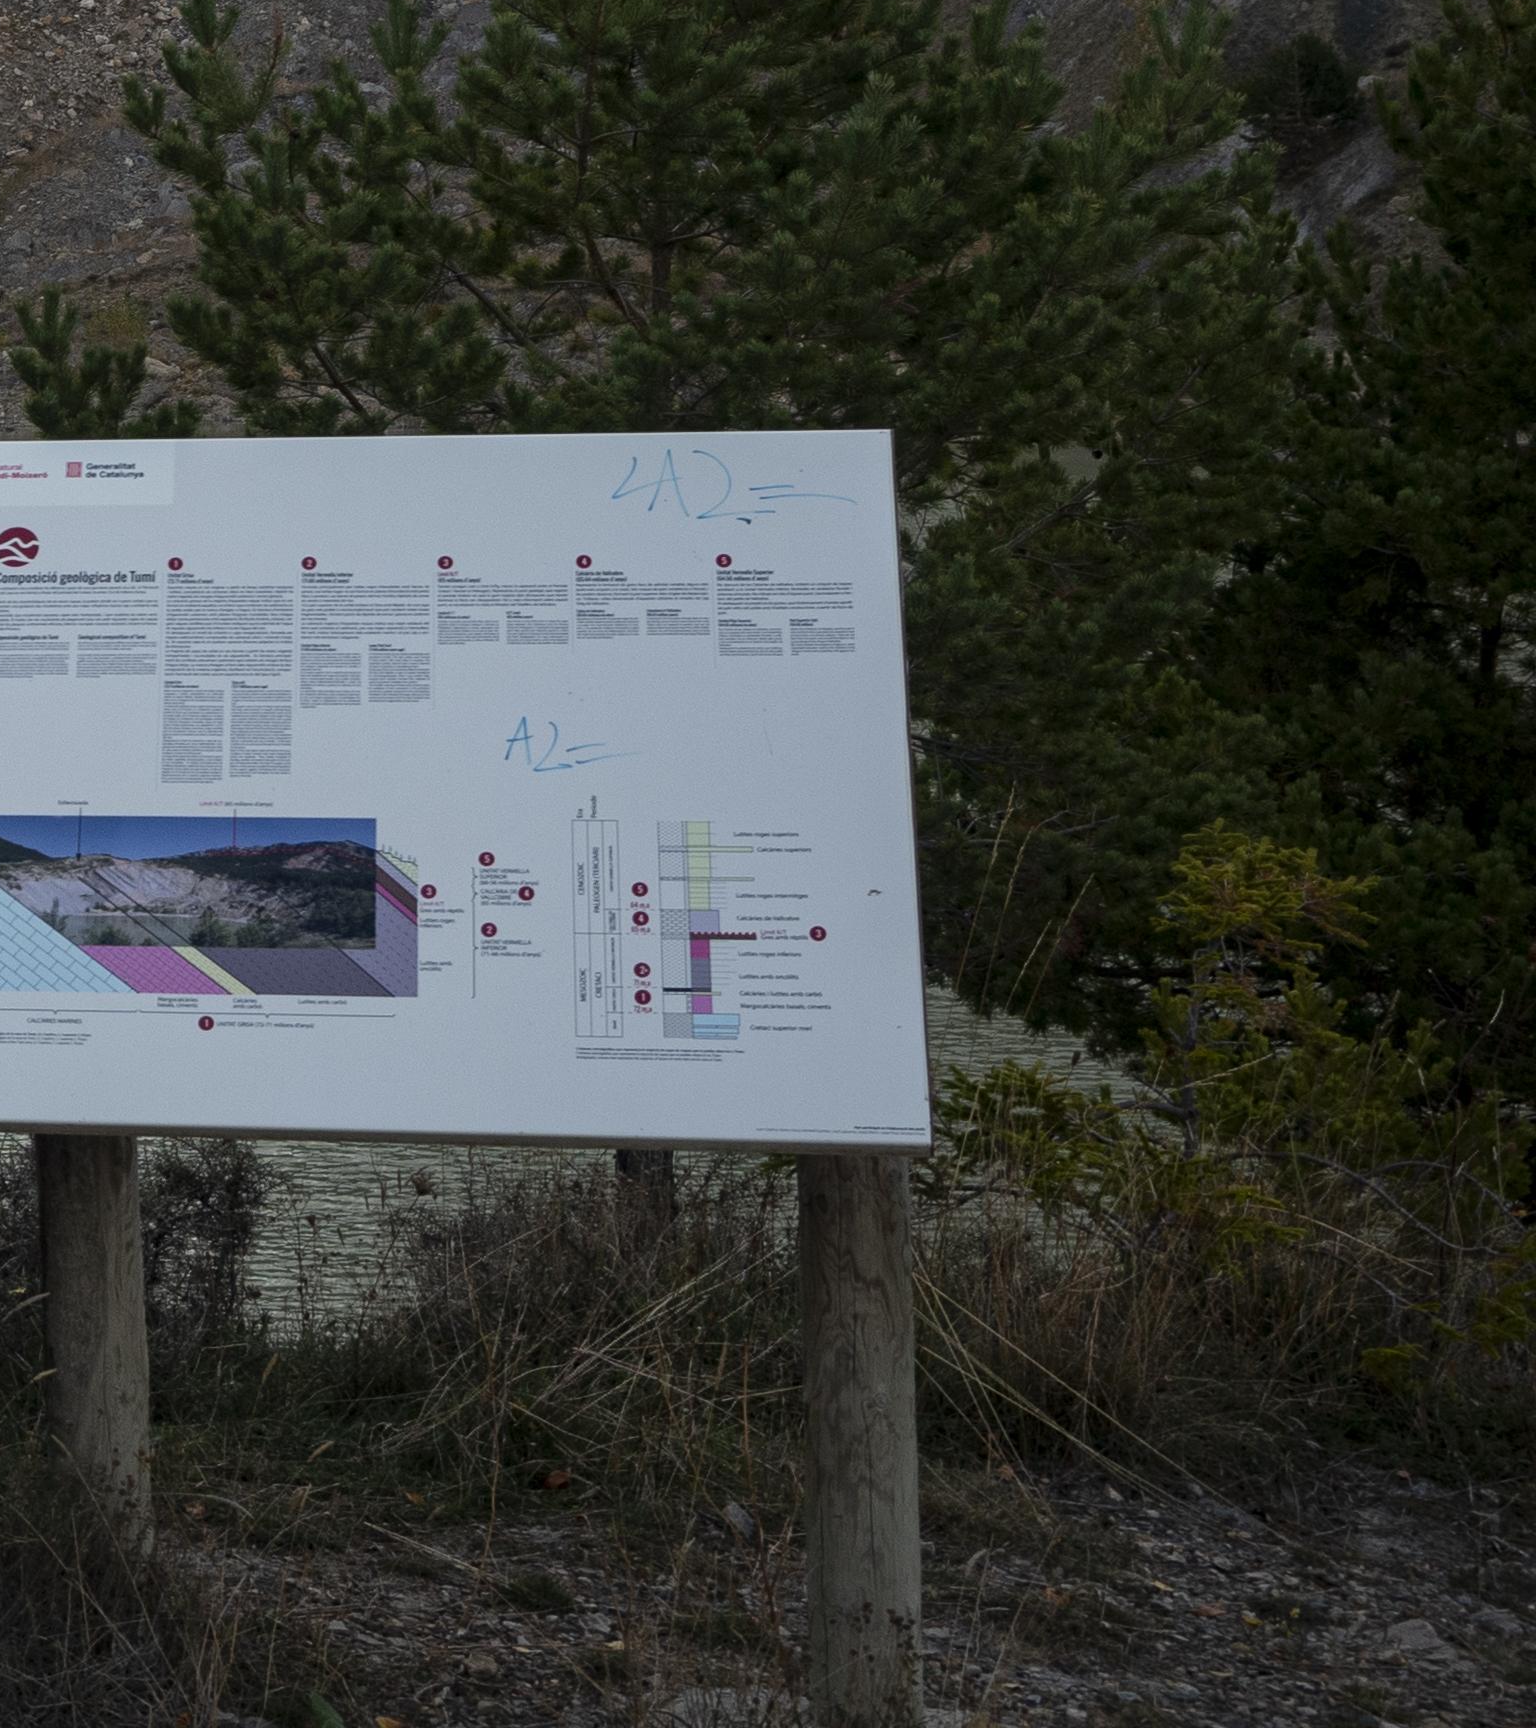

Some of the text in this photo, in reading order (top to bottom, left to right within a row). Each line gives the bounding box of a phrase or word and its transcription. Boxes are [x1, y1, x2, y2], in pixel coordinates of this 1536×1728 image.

[86, 462, 136, 471] Generalitat
[86, 471, 144, 480] de Catalunya
[59, 571, 111, 585] geològica
[113, 571, 128, 583] de
[130, 570, 156, 583] Tumí
[577, 861, 585, 896] CENOZOIC
[579, 967, 587, 1002] MESOZOIC
